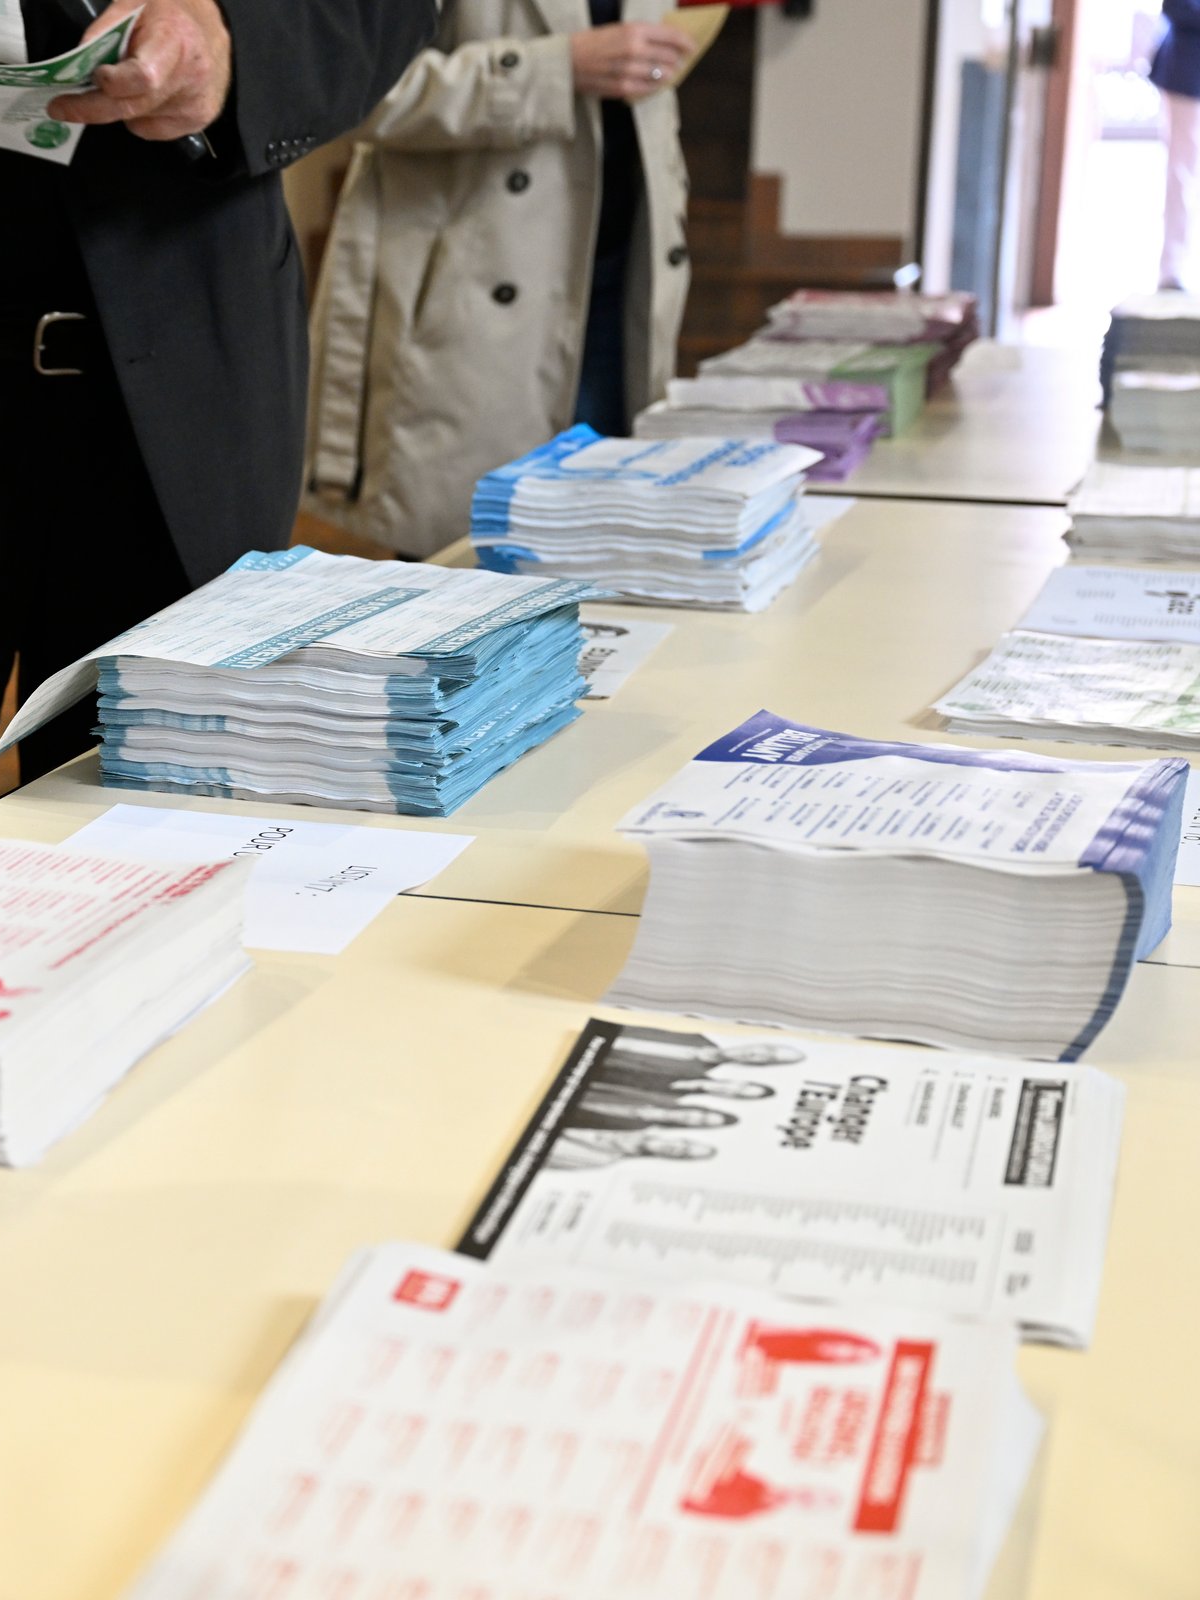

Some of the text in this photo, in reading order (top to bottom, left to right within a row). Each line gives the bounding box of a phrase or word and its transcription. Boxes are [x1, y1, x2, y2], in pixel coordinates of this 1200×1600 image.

[741, 728, 822, 762] BELLAMY
[242, 826, 294, 850] POUR
[776, 1079, 843, 1149] l'Europe
[825, 1075, 889, 1145] Changer
